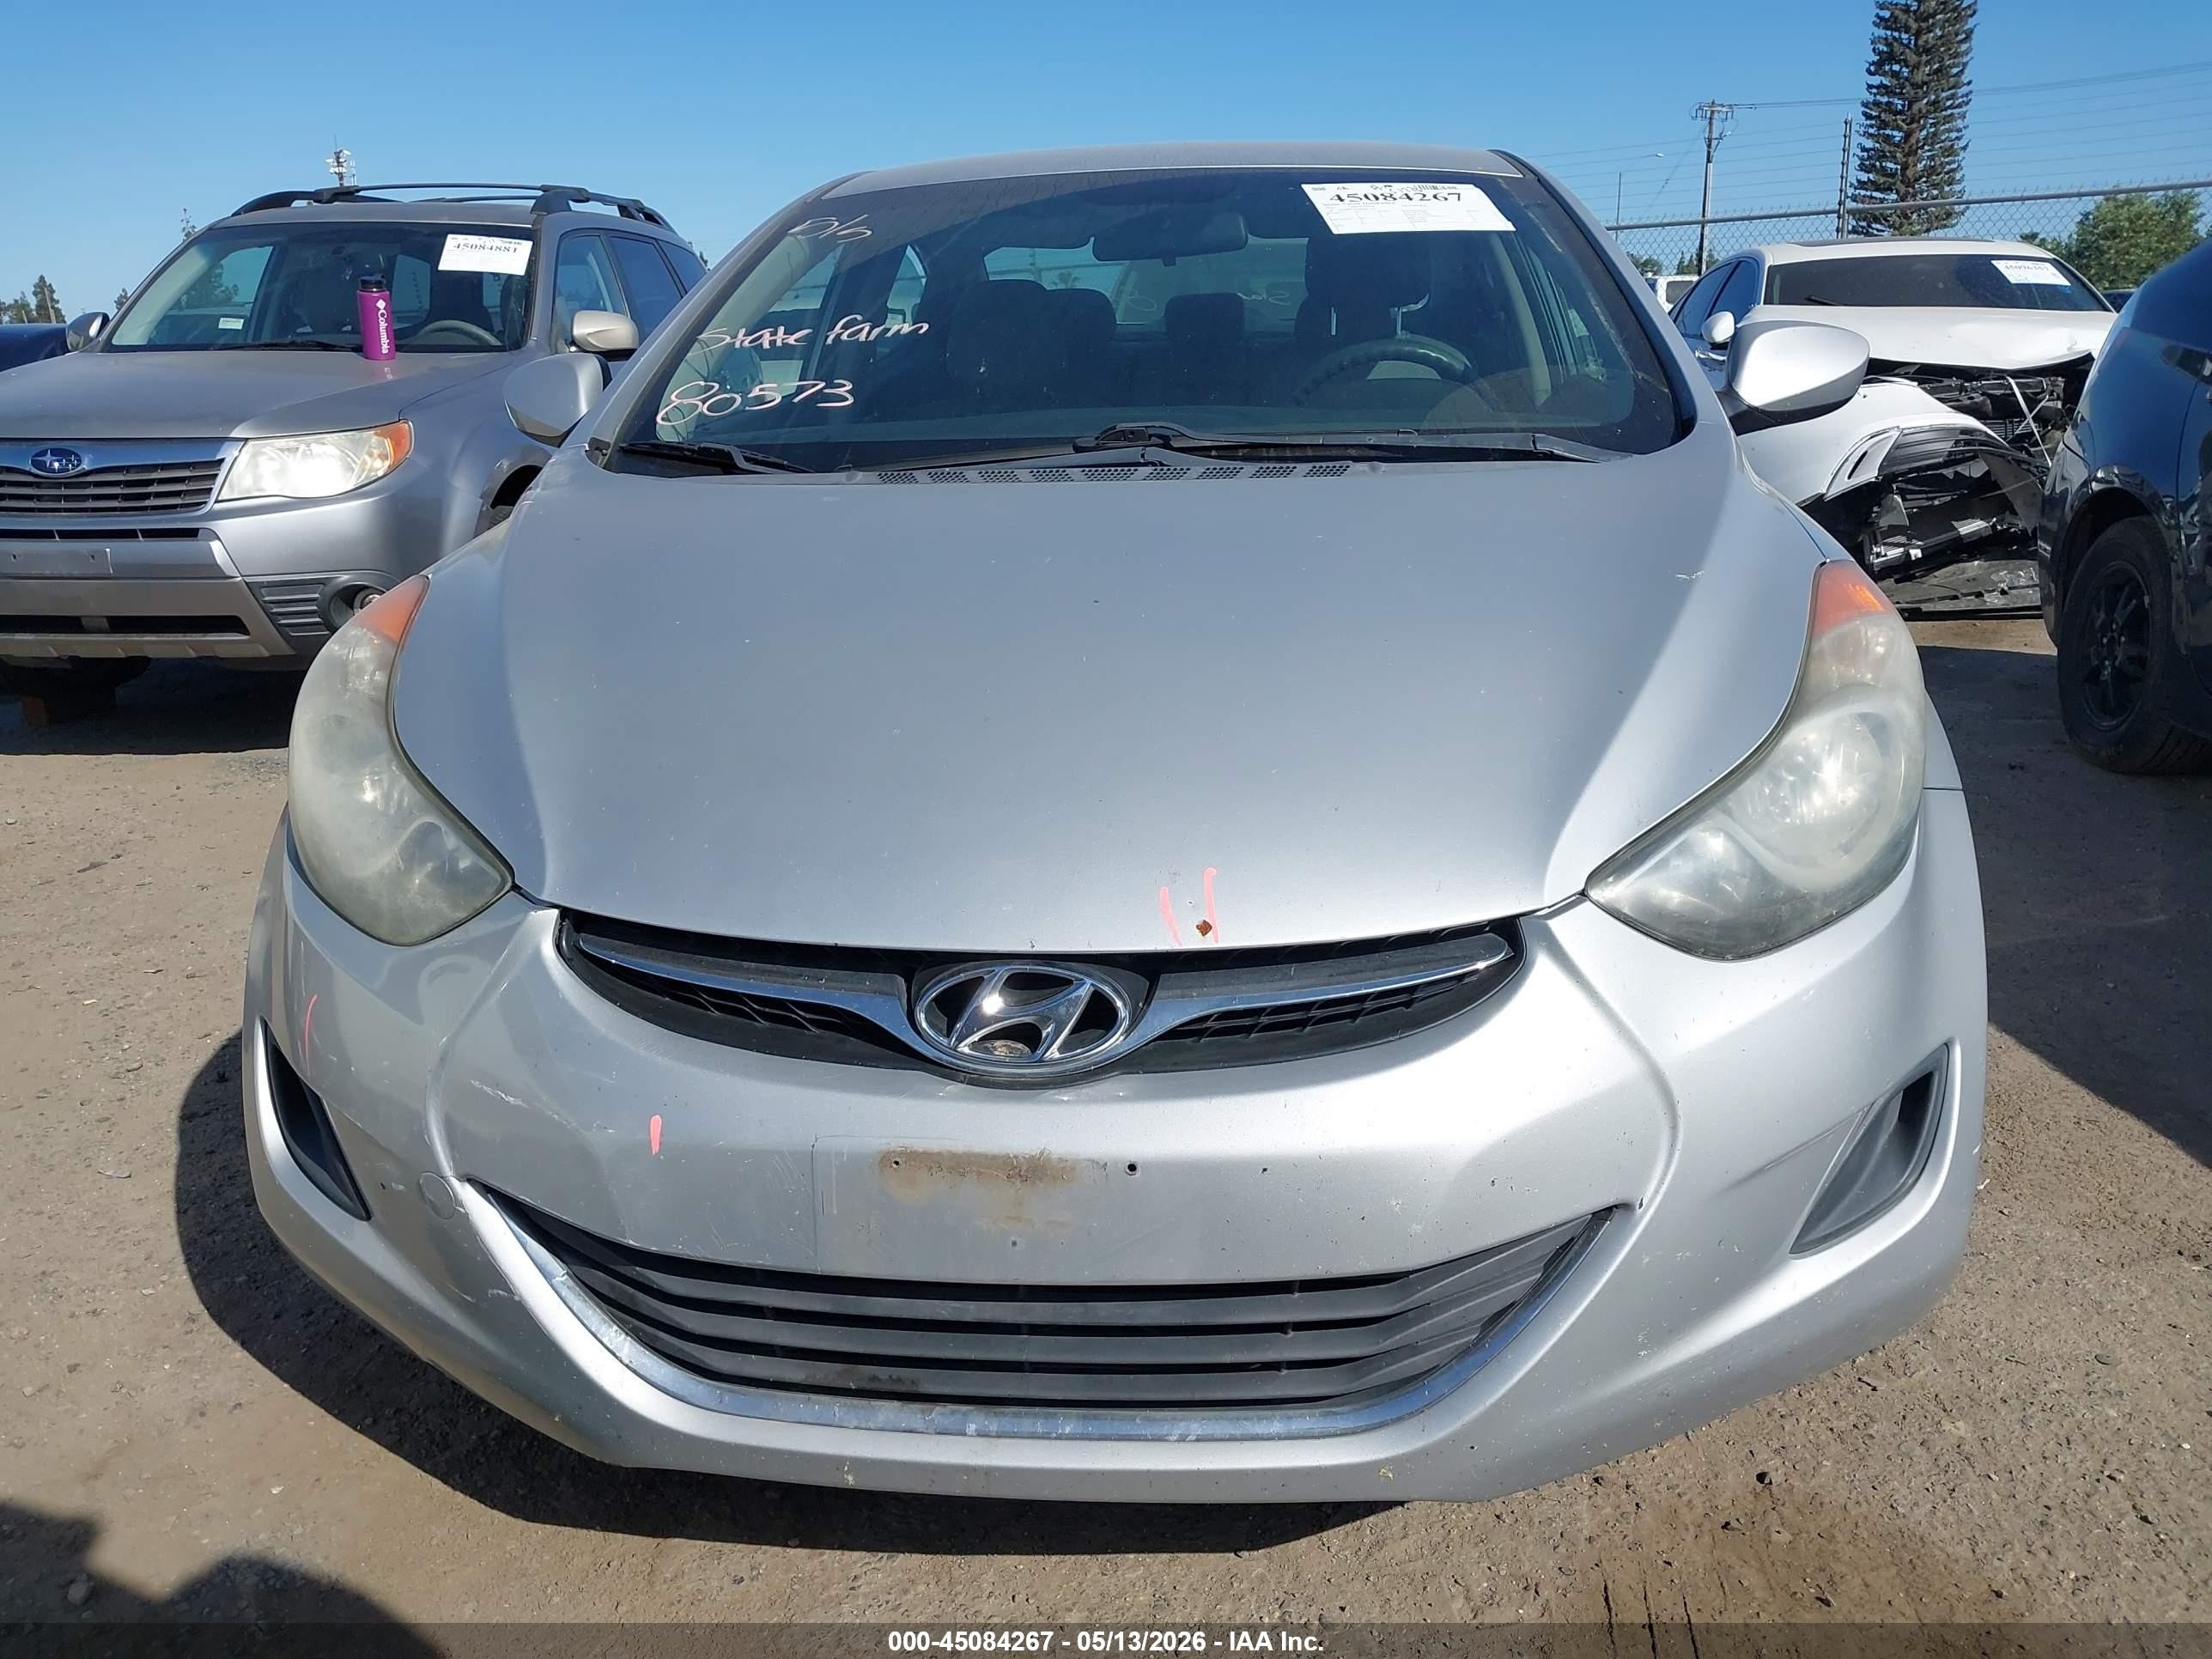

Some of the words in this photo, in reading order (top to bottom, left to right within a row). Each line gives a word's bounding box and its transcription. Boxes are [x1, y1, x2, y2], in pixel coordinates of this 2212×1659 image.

[1329, 191, 1462, 204] 45084267
[453, 242, 518, 253] 45084881
[378, 309, 391, 355] Columbia
[656, 379, 854, 426] 80573
